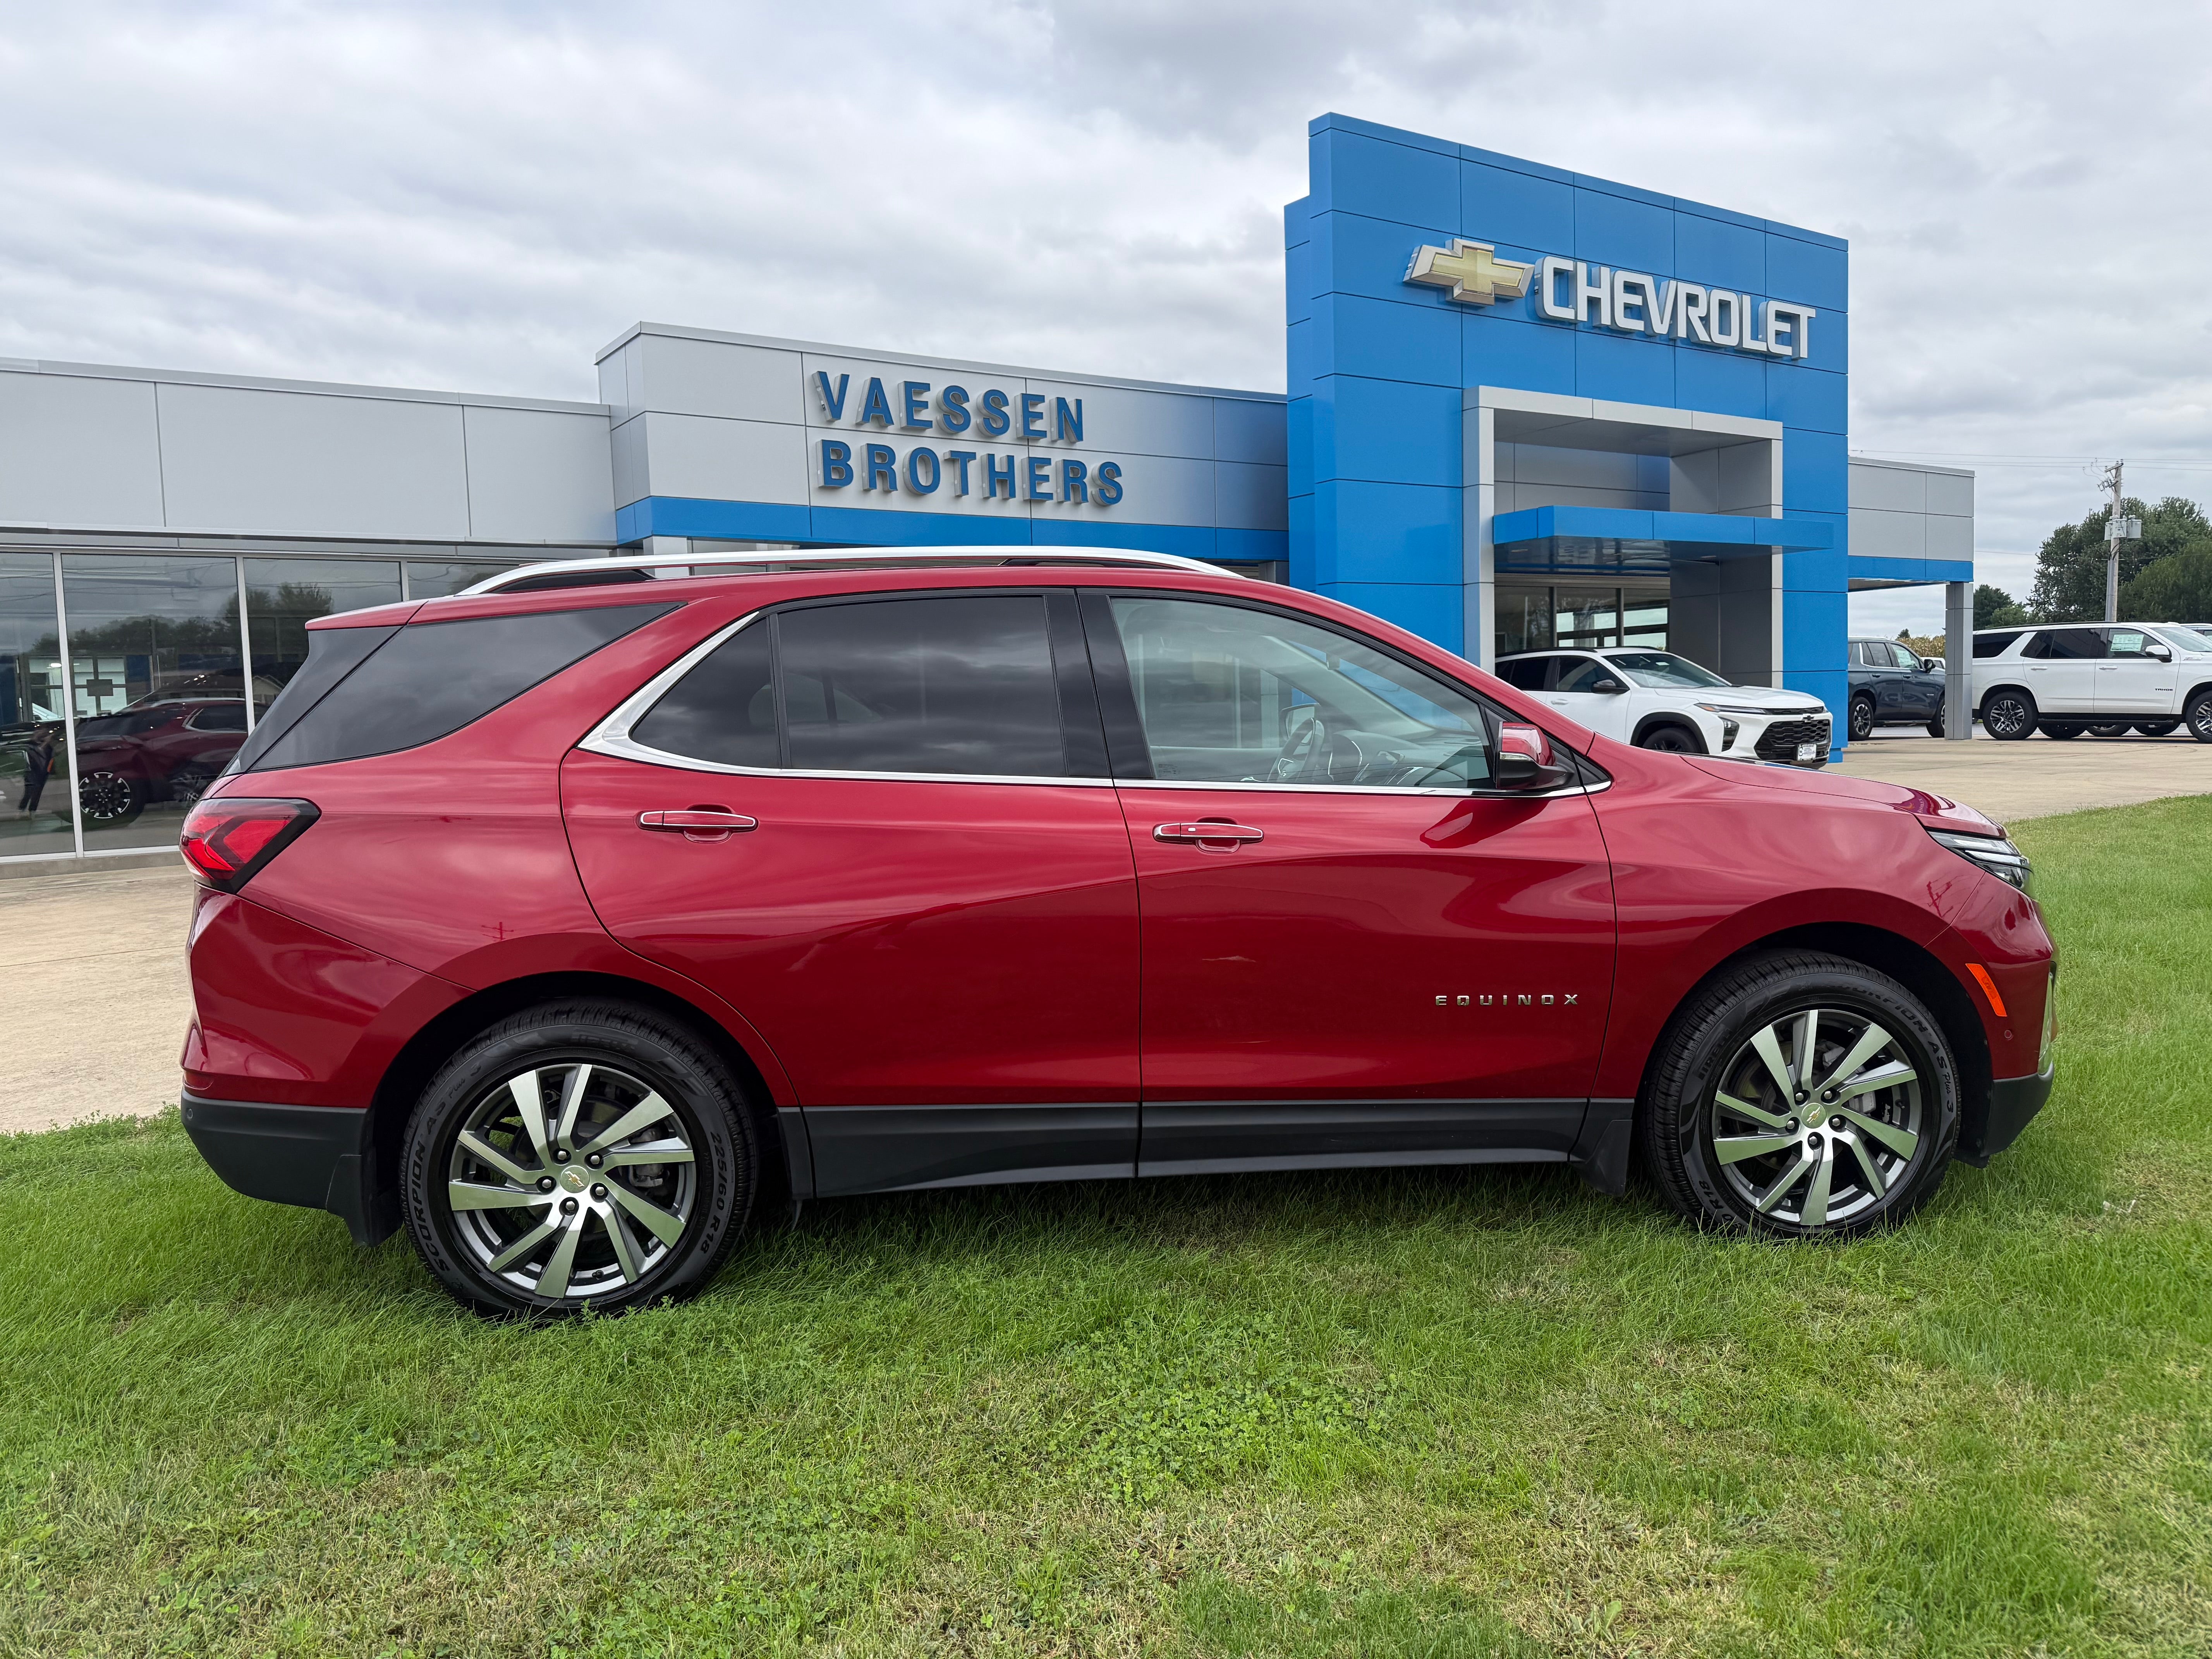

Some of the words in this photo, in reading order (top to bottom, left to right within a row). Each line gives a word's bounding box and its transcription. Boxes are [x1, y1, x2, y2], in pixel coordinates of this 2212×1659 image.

[1534, 256, 1816, 360] CHEVROLET
[812, 371, 1084, 443] VAESSEN
[816, 439, 1123, 506] BROTHERS
[1436, 994, 1578, 1006] EQUINOX
[1928, 1041, 1947, 1068] AS
[1942, 1072, 1951, 1094] Plus
[1947, 1100, 1954, 1113] 3
[427, 1097, 446, 1135] AS
[412, 1140, 450, 1271] SCORPION
[710, 1132, 727, 1211] 225/60
